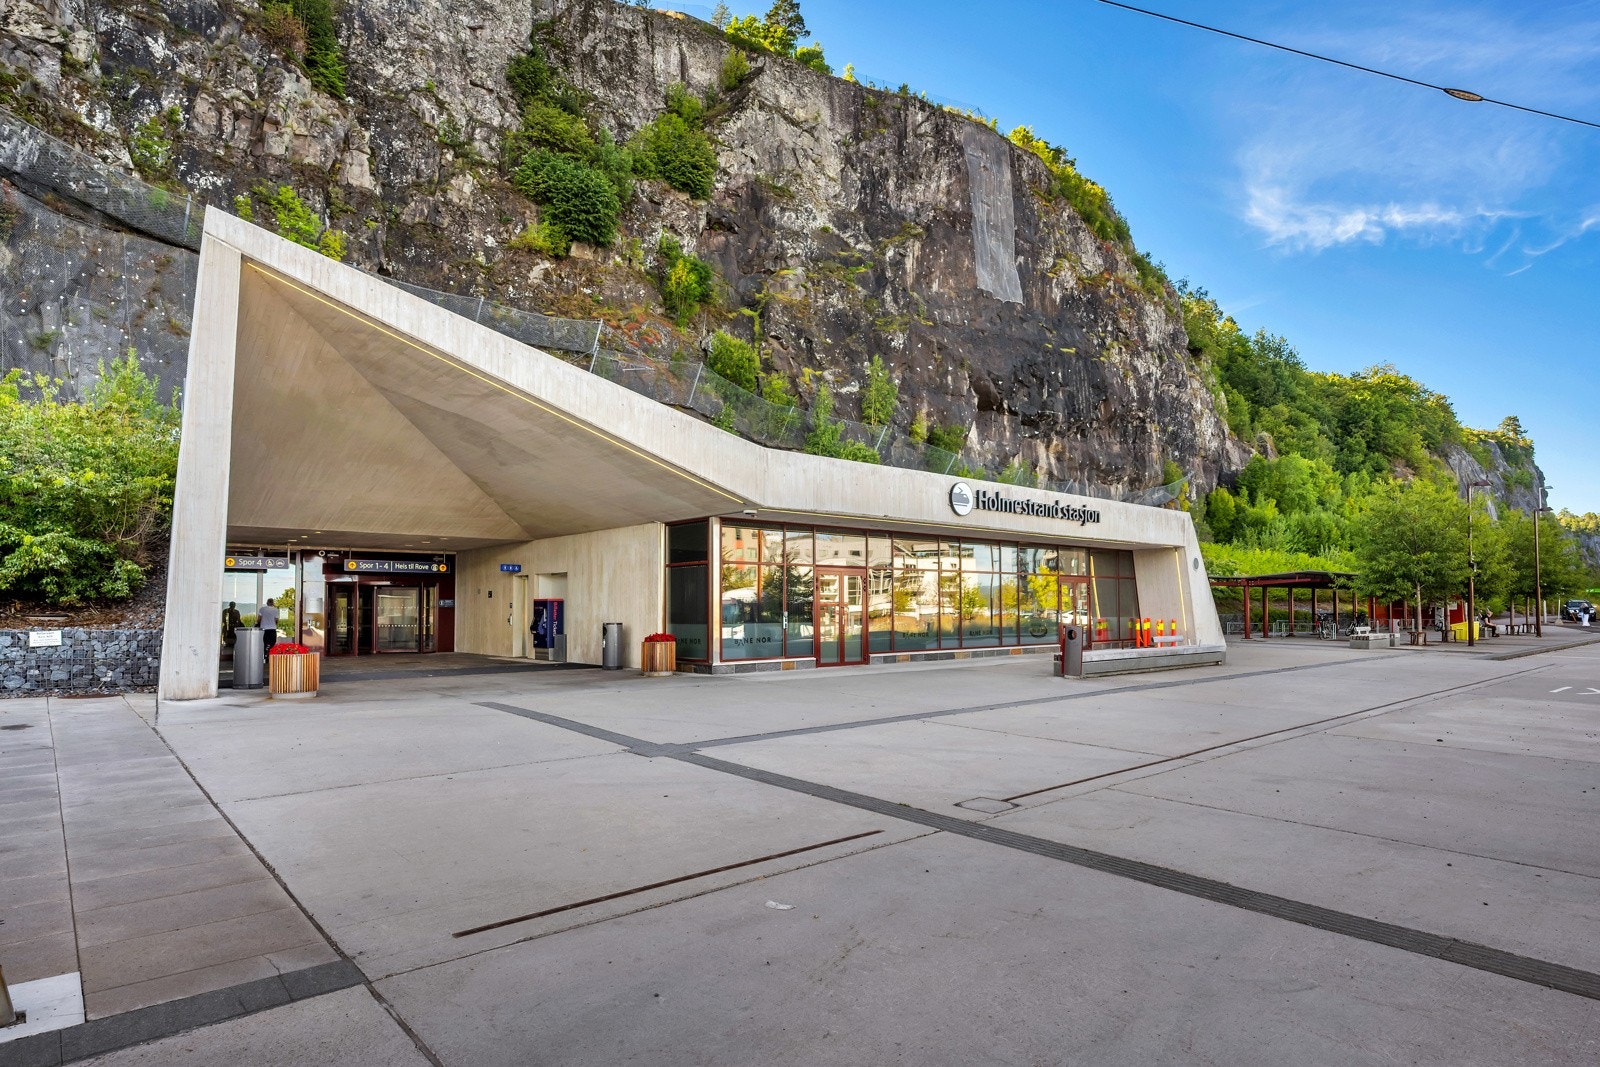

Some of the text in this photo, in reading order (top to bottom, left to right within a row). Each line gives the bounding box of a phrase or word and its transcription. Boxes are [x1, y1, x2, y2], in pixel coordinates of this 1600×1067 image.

[975, 489, 1100, 526] Holmestrand stasjon
[238, 558, 263, 567] Spor 4
[359, 561, 374, 569] Spor
[415, 563, 429, 571] Rove
[734, 636, 772, 647] BANE NOR
